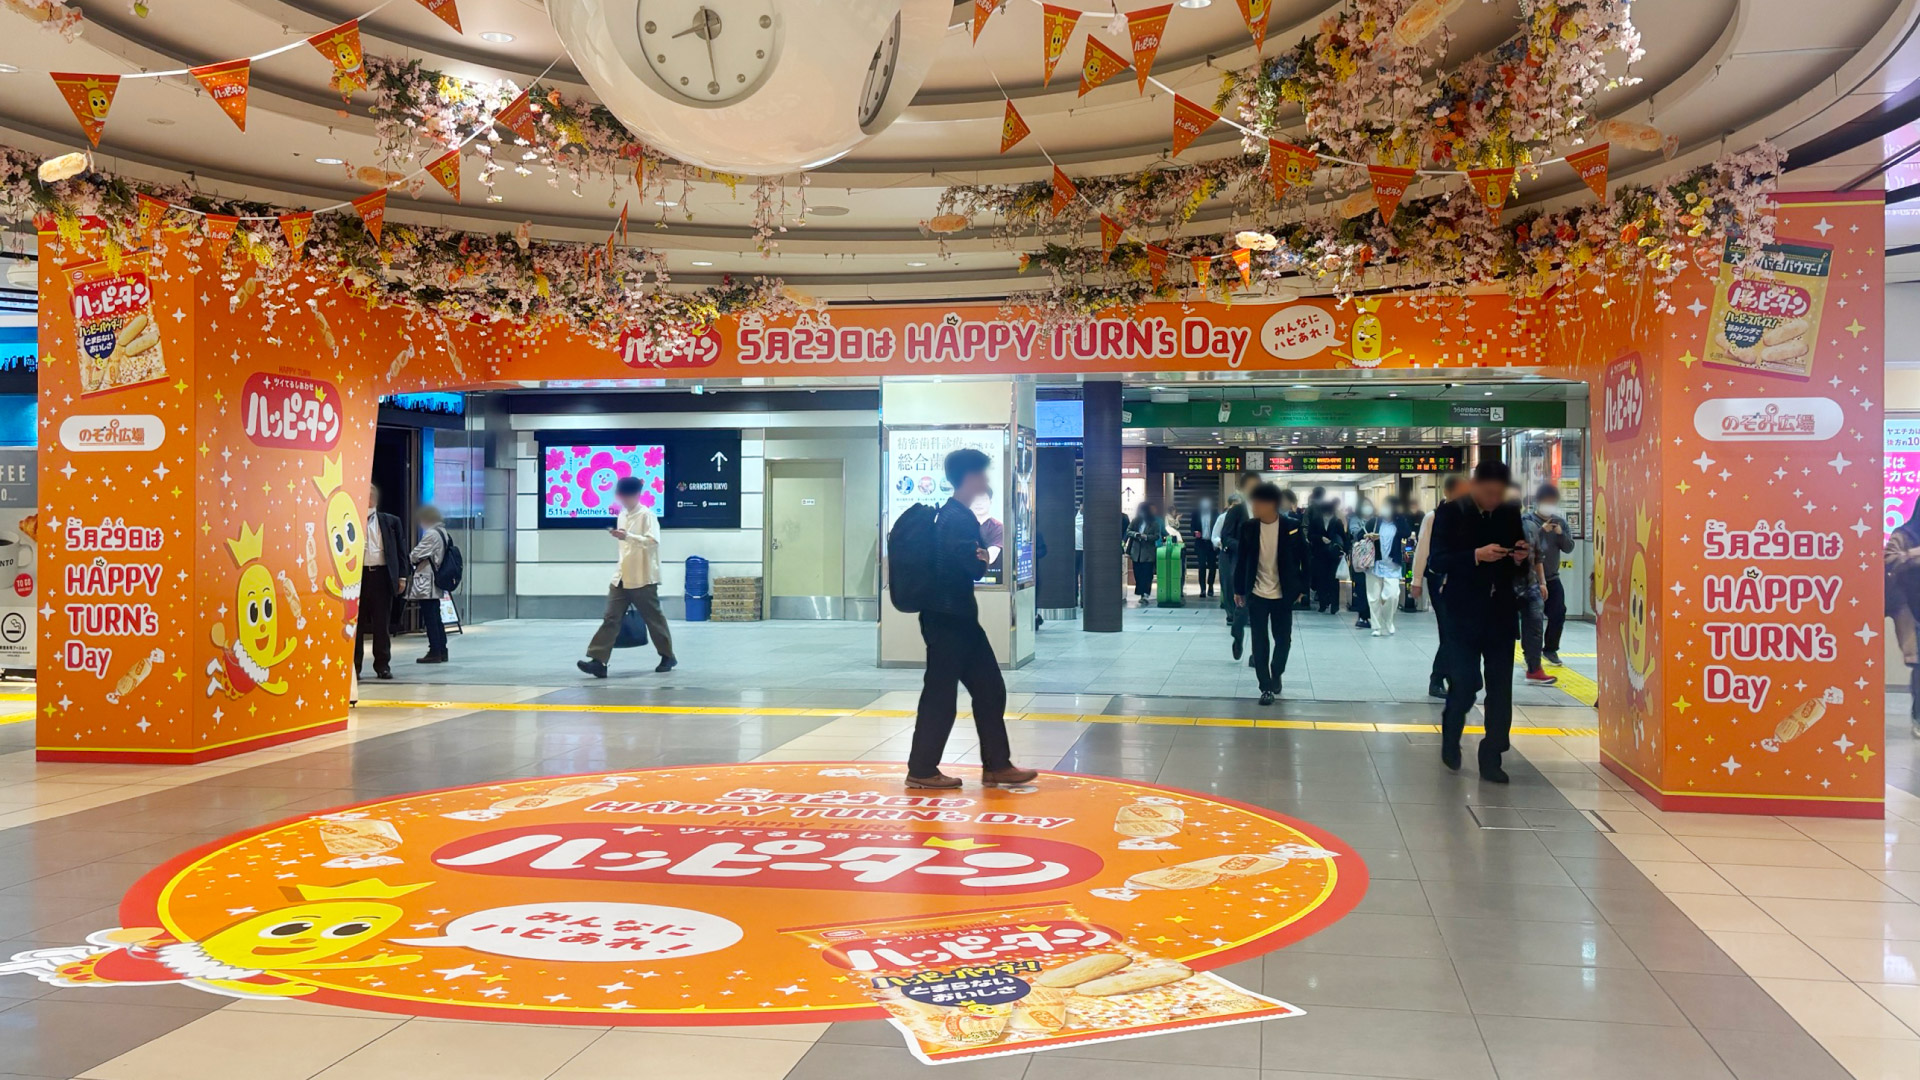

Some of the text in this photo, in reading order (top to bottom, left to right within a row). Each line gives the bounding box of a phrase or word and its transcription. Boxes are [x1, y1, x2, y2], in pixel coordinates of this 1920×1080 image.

[75, 283, 151, 319] ハッピーターン
[1274, 314, 1320, 335] みんなに
[1726, 311, 1778, 329] ハッピースパイス!
[739, 317, 1250, 367] 5月29日は HAPPY TURN's Day
[1274, 323, 1330, 351] ハピあれ!
[273, 378, 315, 391] ツイてるしあわせ
[1252, 405, 1272, 417] JR
[1604, 374, 1643, 434] ハッピーターン
[245, 392, 339, 443] ハッピーターン
[1722, 414, 1815, 434] のぞみ広場
[79, 427, 145, 443] のぞみ広場
[1884, 471, 1920, 483] カで!
[576, 507, 607, 515] Mother's
[67, 527, 162, 549] 5月29日は
[1706, 532, 1842, 557] 5月29日は
[67, 566, 161, 594] HAPPY
[1706, 578, 1840, 611] HAPPY
[66, 606, 157, 634] TURN's
[1706, 625, 1835, 659] TURN's
[67, 642, 110, 677] Day
[1706, 668, 1768, 710] Day
[716, 790, 975, 808] 5月29日は
[588, 801, 1073, 829] HAPPY TURN's Day
[717, 819, 906, 832] HAPPY TURN
[680, 827, 914, 841] ツイてるしあわせ
[436, 834, 1070, 888] ハッピーターン
[525, 911, 697, 936] みんなに
[900, 926, 1011, 942] ツイてるしあわせ
[472, 923, 693, 955] ハピあれ!
[848, 929, 1112, 971] ハッピーターン
[874, 961, 1042, 988] ハッピーパウダー!
[909, 976, 1014, 996] とまらない
[932, 985, 1017, 1002] おいしさ
